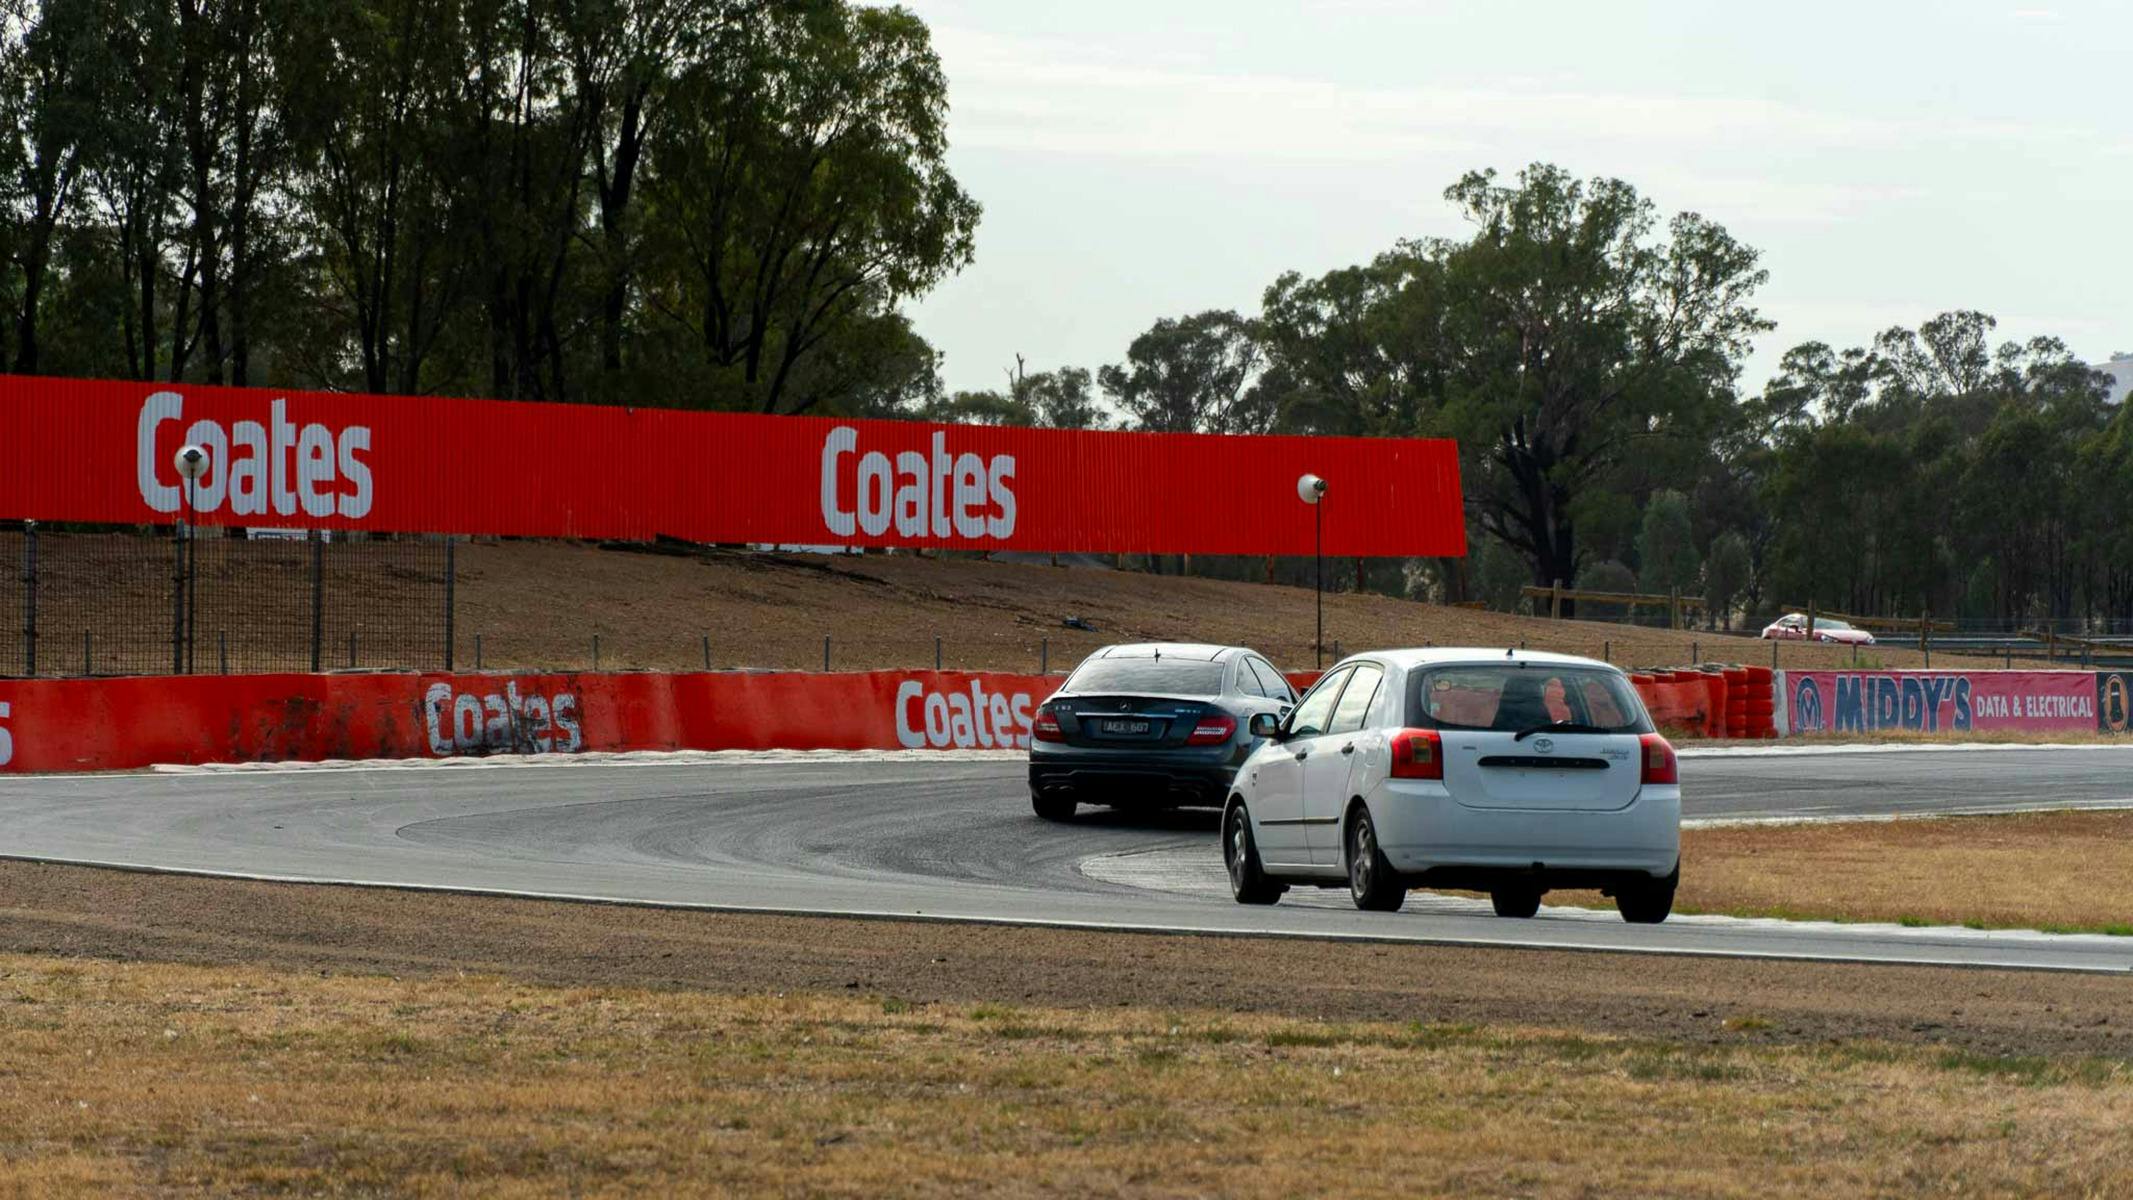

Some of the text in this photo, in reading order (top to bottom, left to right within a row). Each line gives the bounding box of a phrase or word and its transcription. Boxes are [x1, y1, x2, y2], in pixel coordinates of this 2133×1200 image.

[137, 391, 373, 519] Coates
[821, 426, 1016, 539] Coates
[426, 681, 581, 753] Coates
[896, 679, 1033, 748] Coates
[1834, 675, 1972, 733] MIDDY'S
[1976, 695, 2094, 717] DATA & ELECTRICAL
